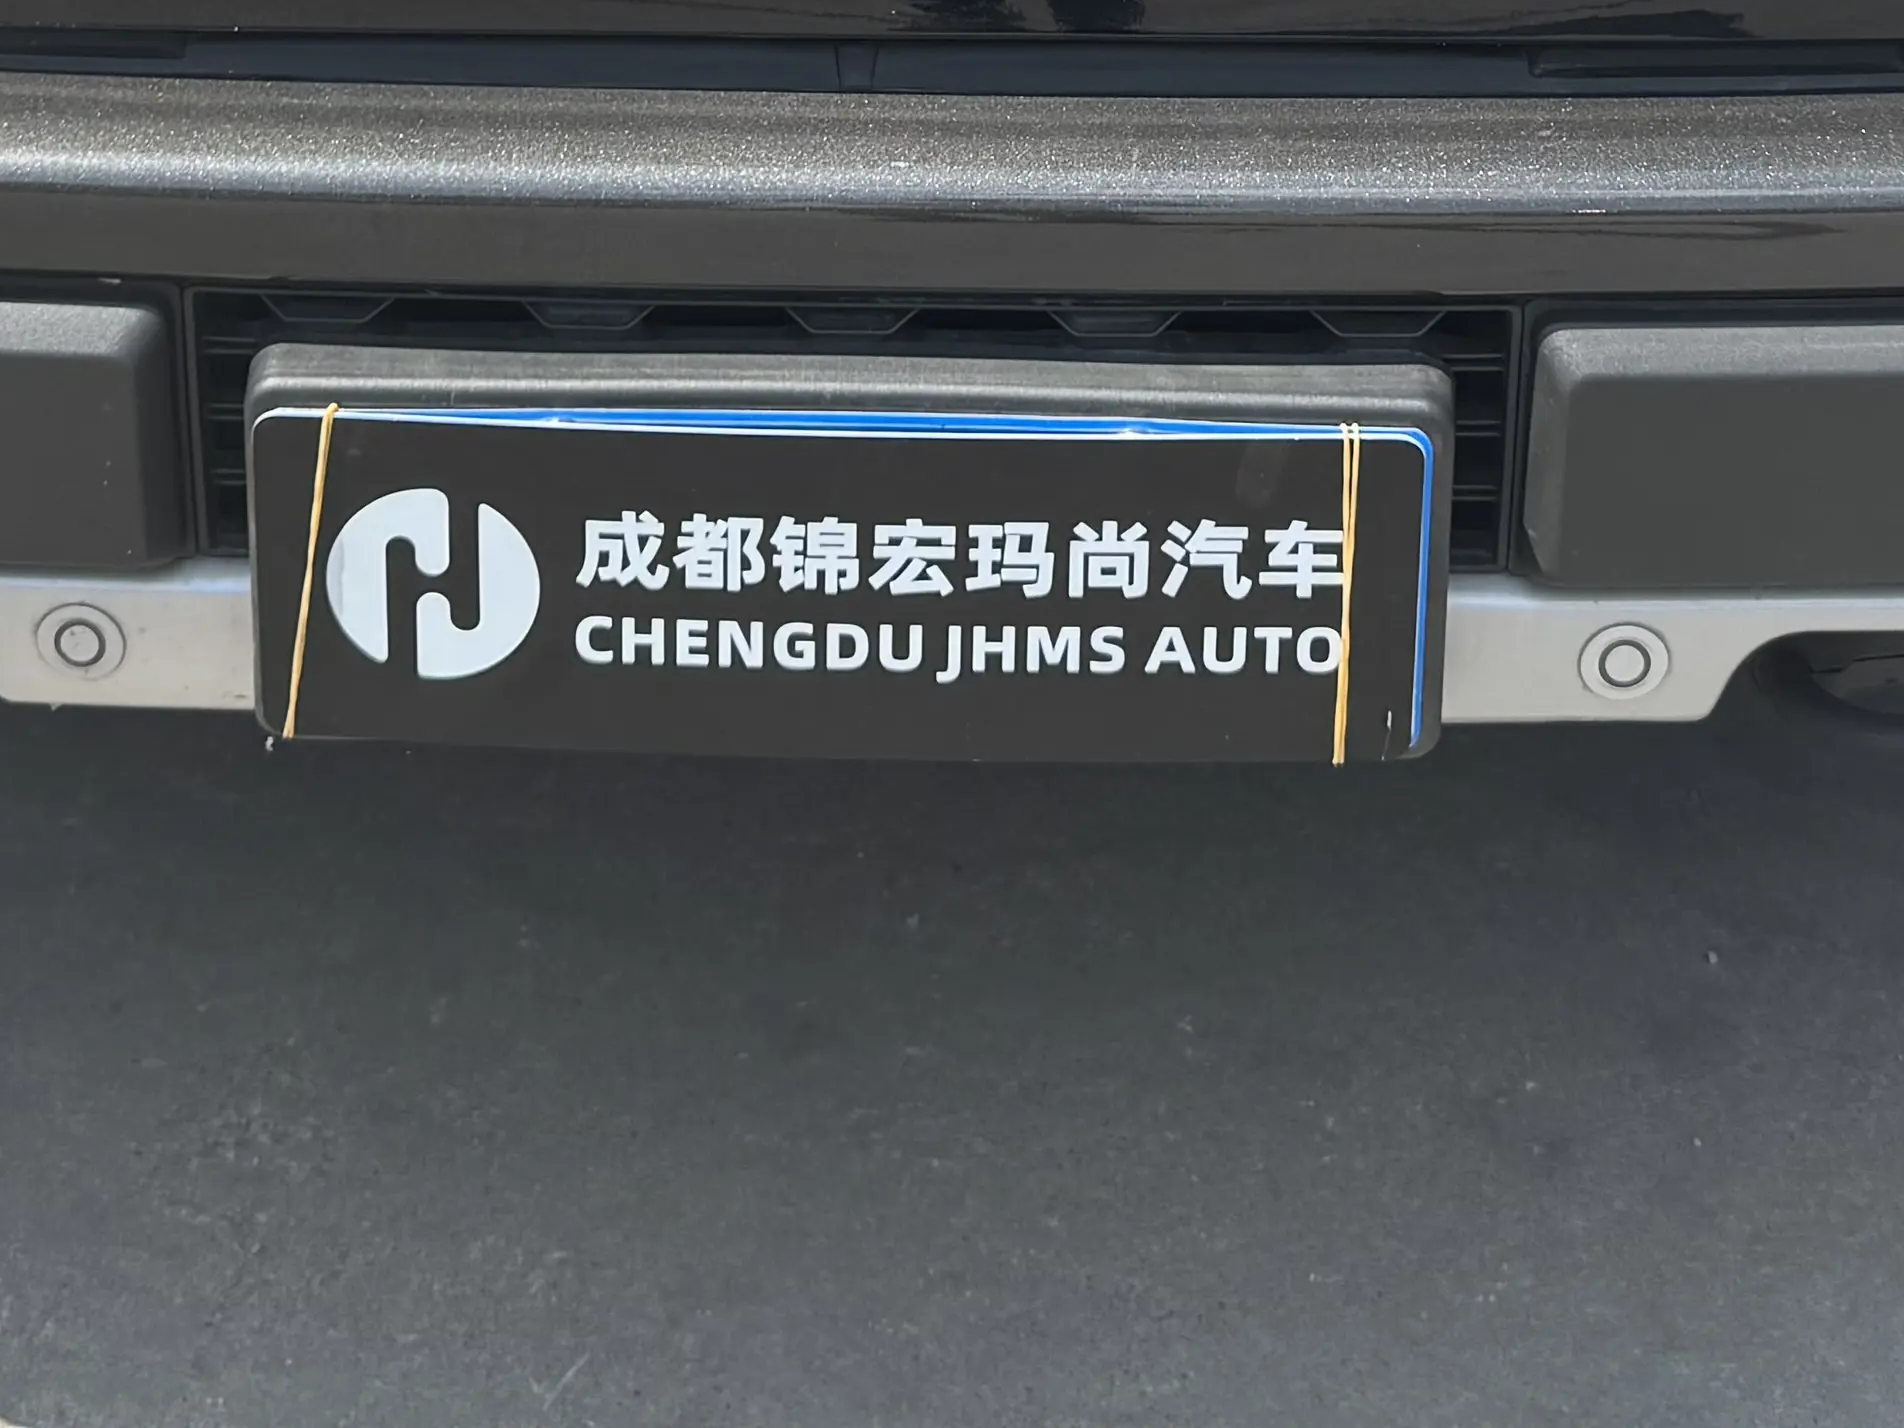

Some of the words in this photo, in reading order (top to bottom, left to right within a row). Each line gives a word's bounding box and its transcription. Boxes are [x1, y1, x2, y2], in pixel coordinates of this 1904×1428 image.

[575, 510, 1345, 601] 成都锦宏玛尚汽车
[574, 615, 923, 672] CHENGDU
[936, 624, 1126, 684] JHMS
[1144, 625, 1343, 674] AUTO
